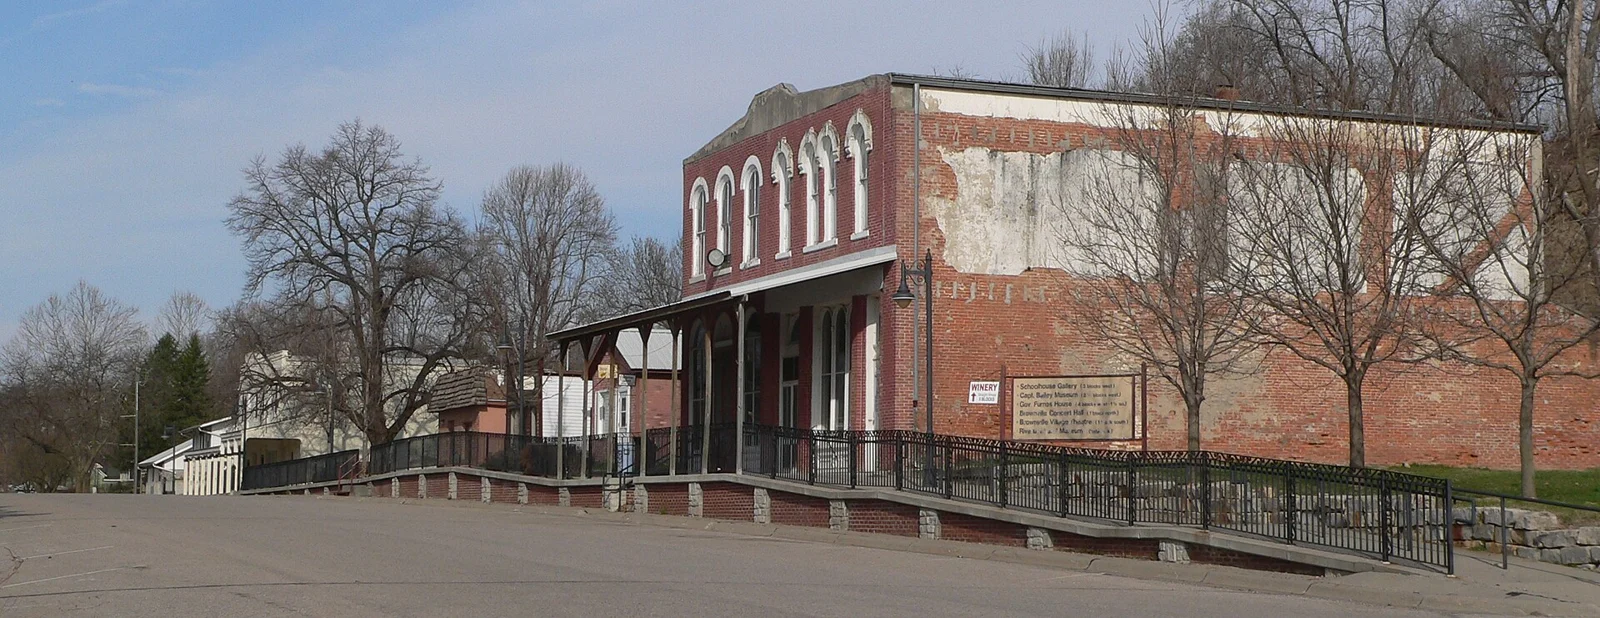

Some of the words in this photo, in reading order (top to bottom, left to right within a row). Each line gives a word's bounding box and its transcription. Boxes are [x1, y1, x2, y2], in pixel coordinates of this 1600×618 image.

[972, 383, 998, 391] WINERY
[1057, 382, 1078, 391] Gallery
[1049, 419, 1069, 427] Village
